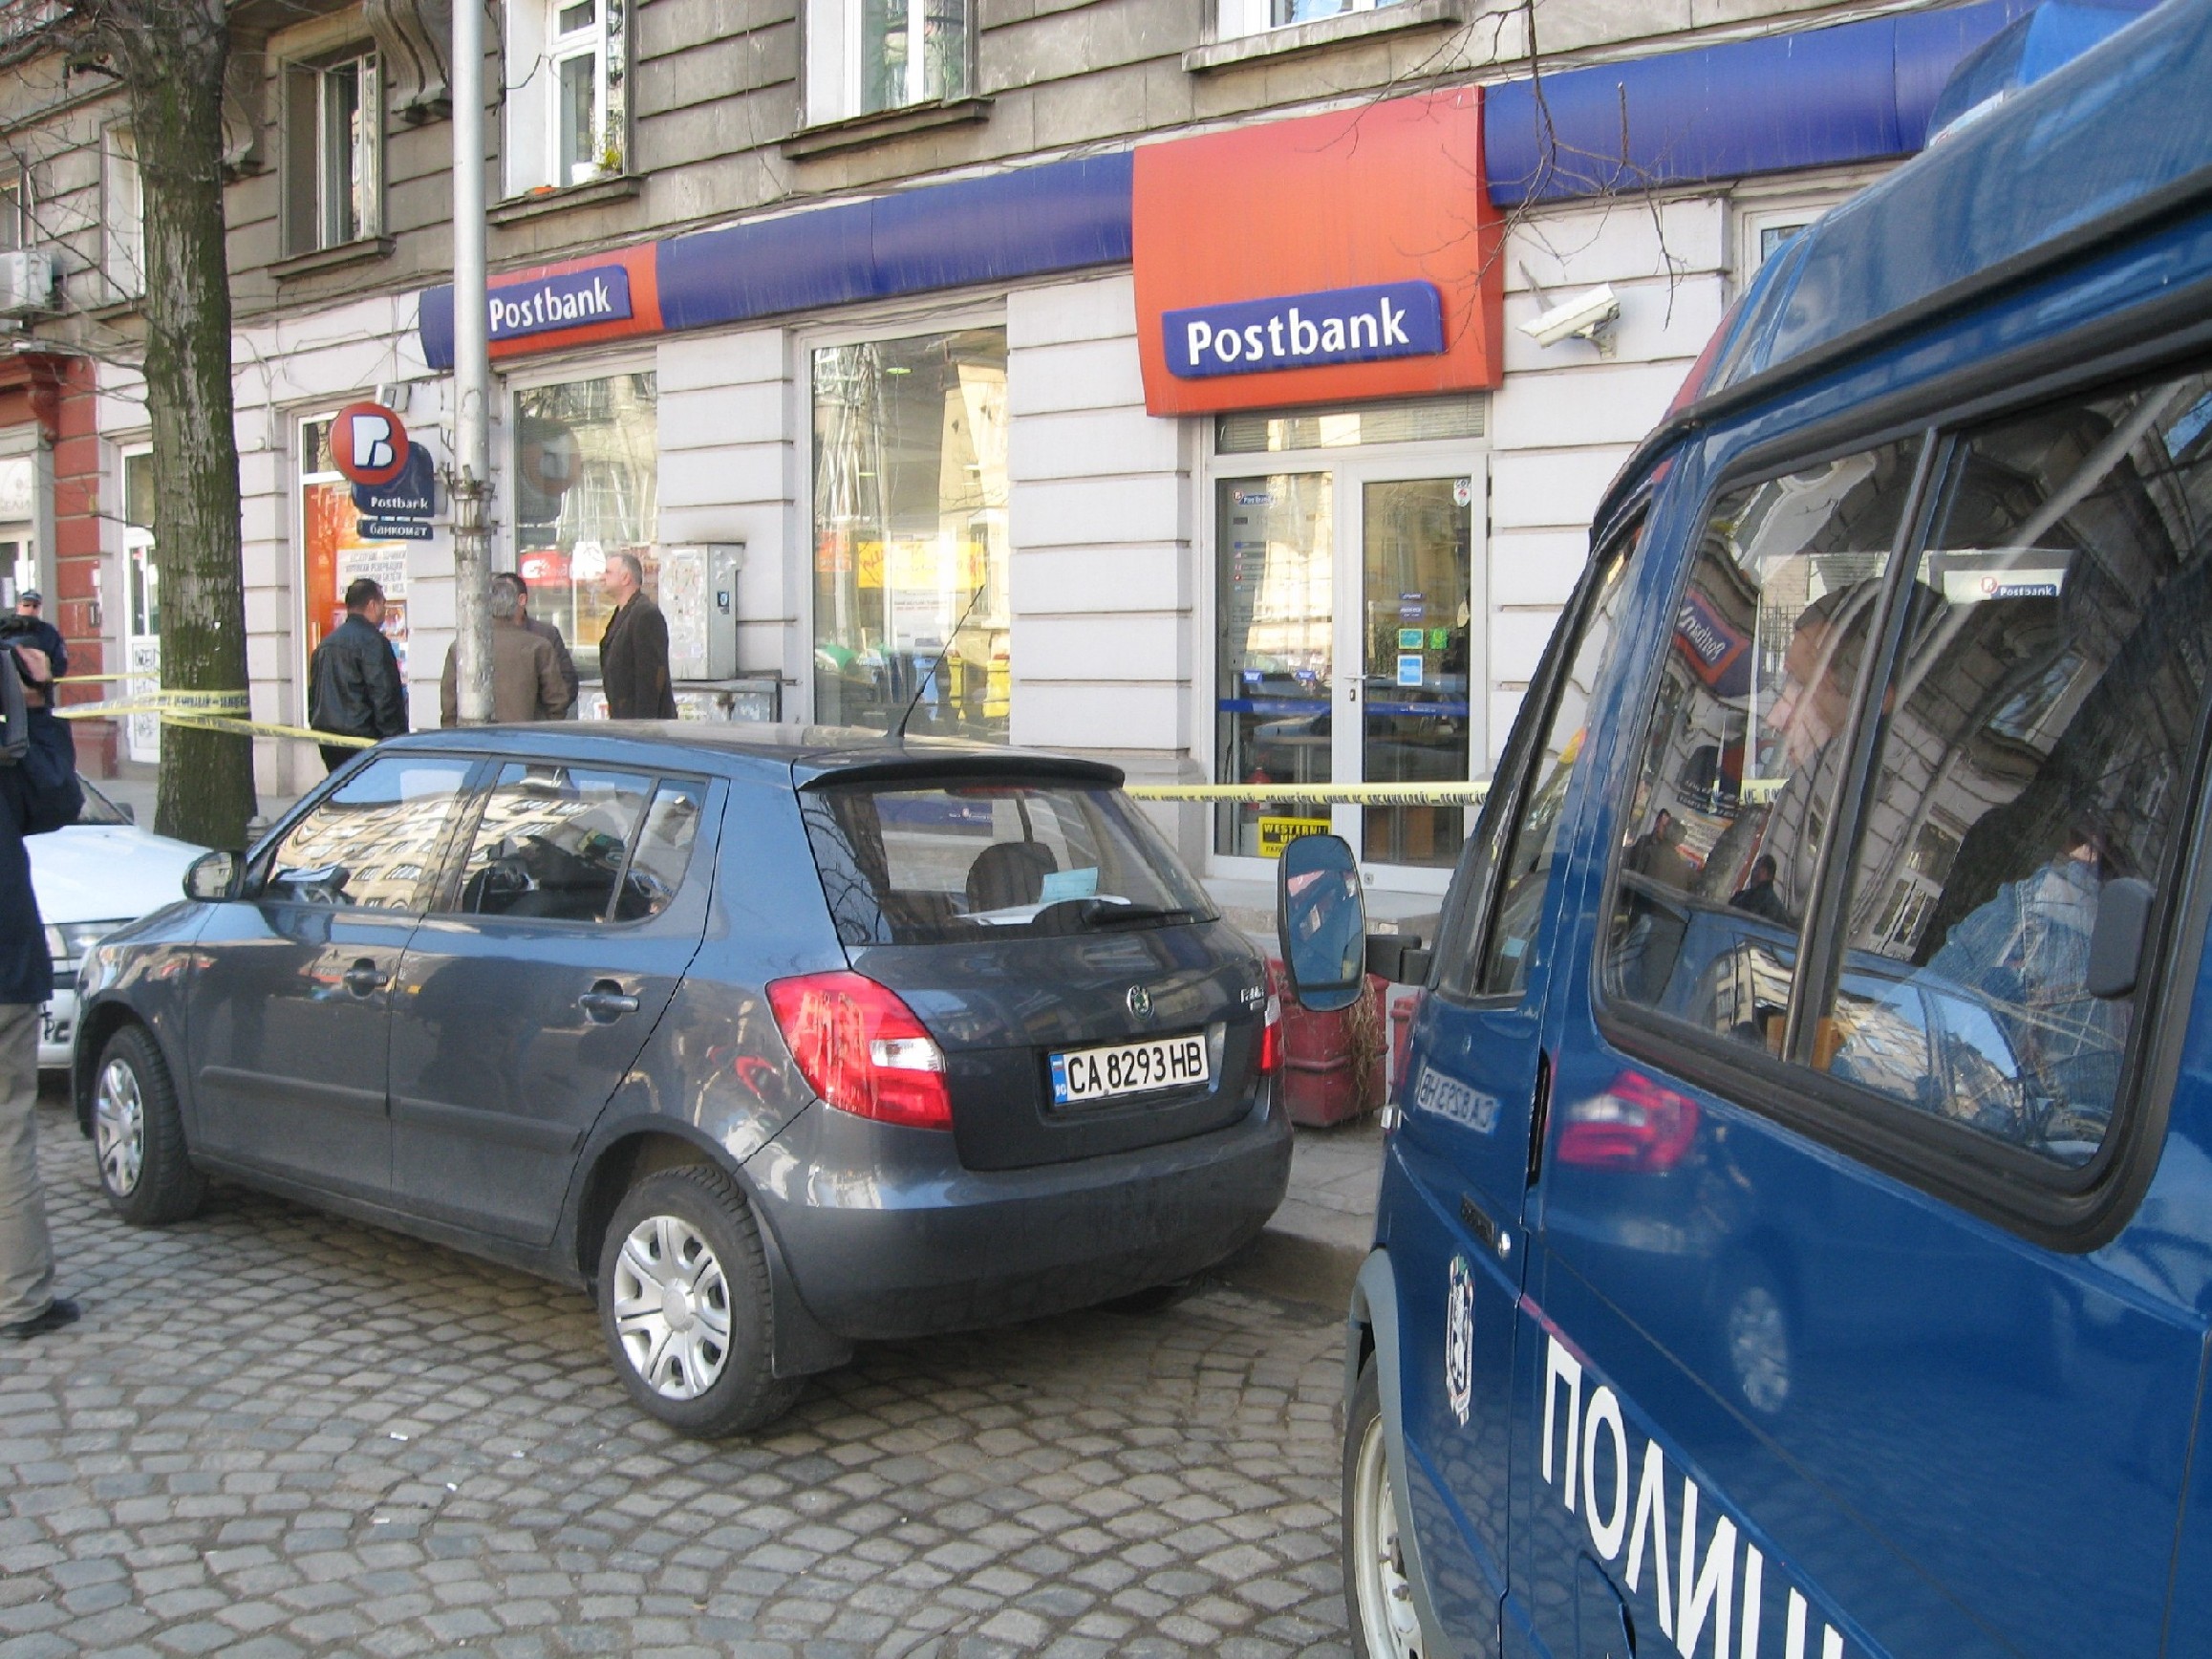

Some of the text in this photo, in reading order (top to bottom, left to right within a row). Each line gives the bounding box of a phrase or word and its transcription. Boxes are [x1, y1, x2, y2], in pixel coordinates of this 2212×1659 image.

[489, 276, 612, 333] Postbank
[1187, 296, 1410, 366] Postbank
[370, 523, 428, 537] банкомат
[371, 496, 429, 510] Postbank
[1541, 1334, 1845, 1659] ПОЛИ
